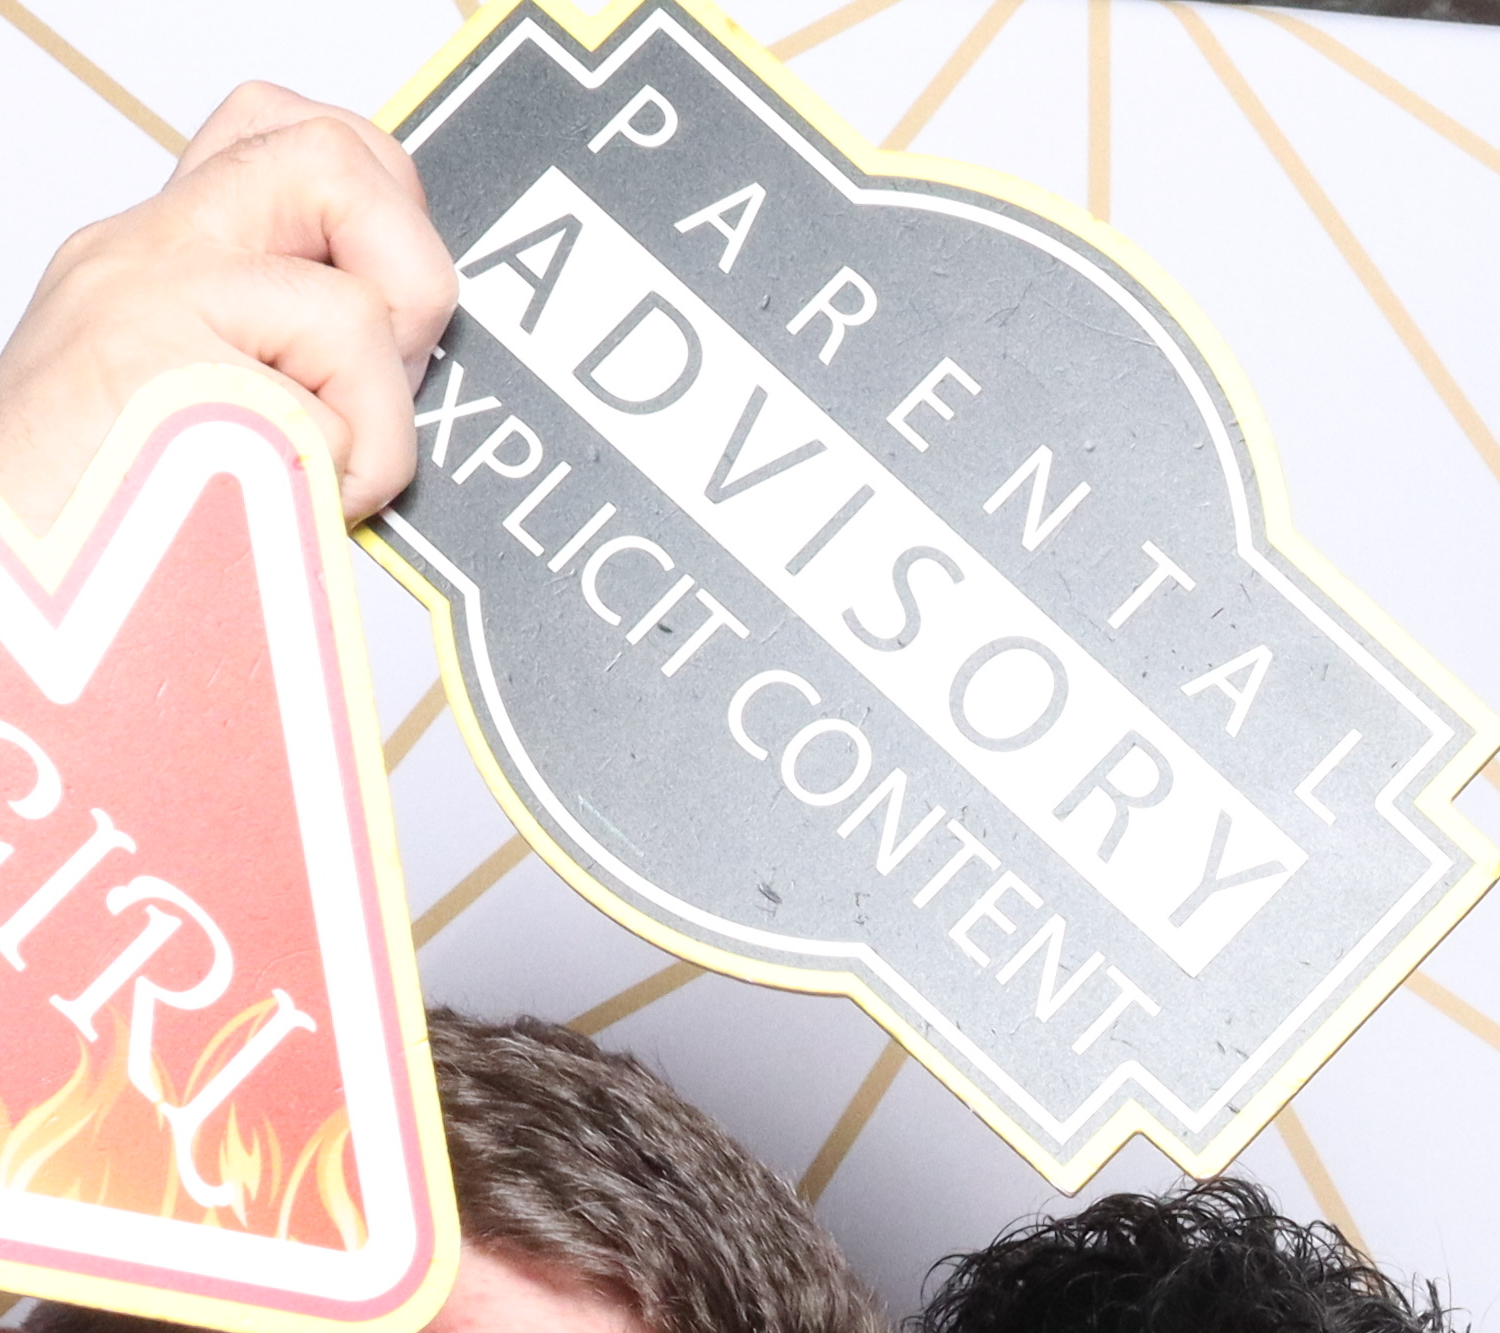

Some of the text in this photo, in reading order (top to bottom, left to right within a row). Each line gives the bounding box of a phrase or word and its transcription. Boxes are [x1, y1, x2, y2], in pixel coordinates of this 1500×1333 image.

[411, 345, 1161, 1055] XPLICIT CONTENT
[460, 212, 1288, 929] ADVISORY
[587, 84, 1362, 824] PARENTAL
